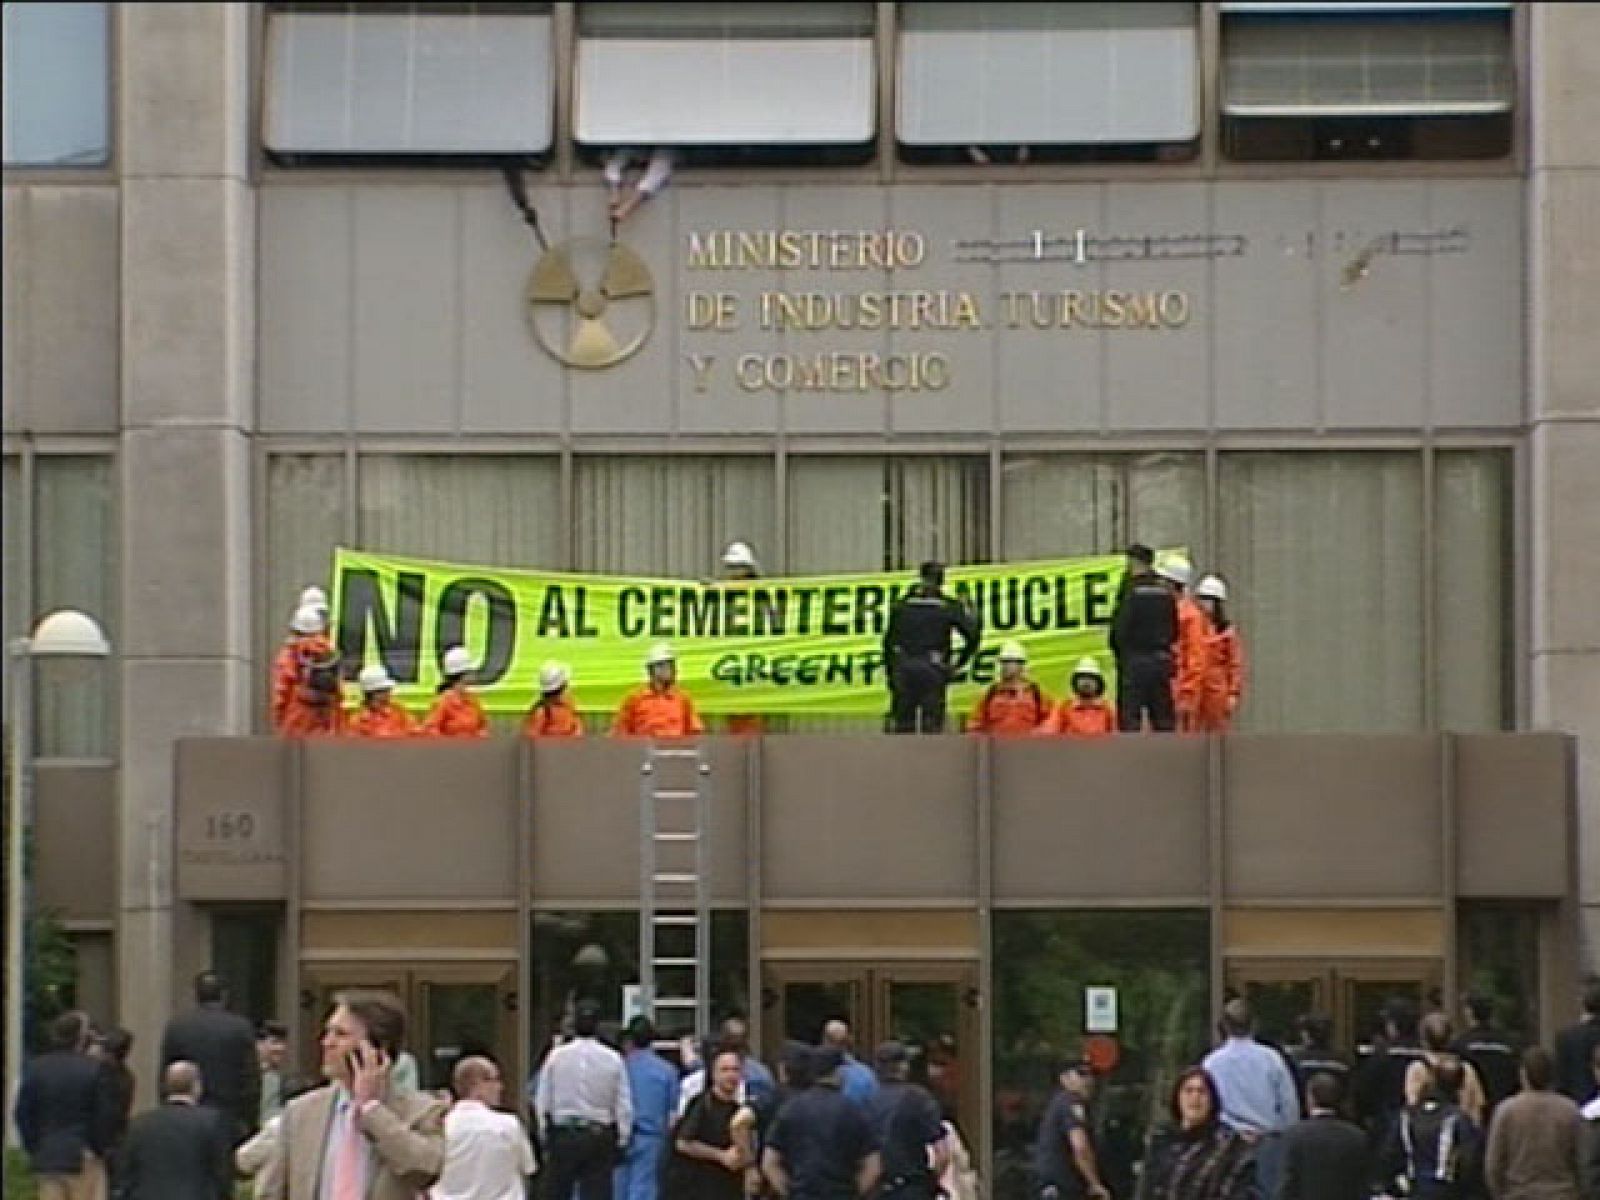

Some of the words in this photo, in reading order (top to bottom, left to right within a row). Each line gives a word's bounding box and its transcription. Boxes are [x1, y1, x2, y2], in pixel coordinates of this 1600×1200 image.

[687, 230, 924, 268] MINISTERIO
[688, 291, 738, 329] DE
[760, 291, 980, 329] INDUSTRIA
[1001, 290, 1190, 329] TURISMO
[687, 352, 716, 391] Y
[736, 352, 948, 391] COMERCIO
[339, 567, 517, 685] NO
[537, 586, 598, 637] AL
